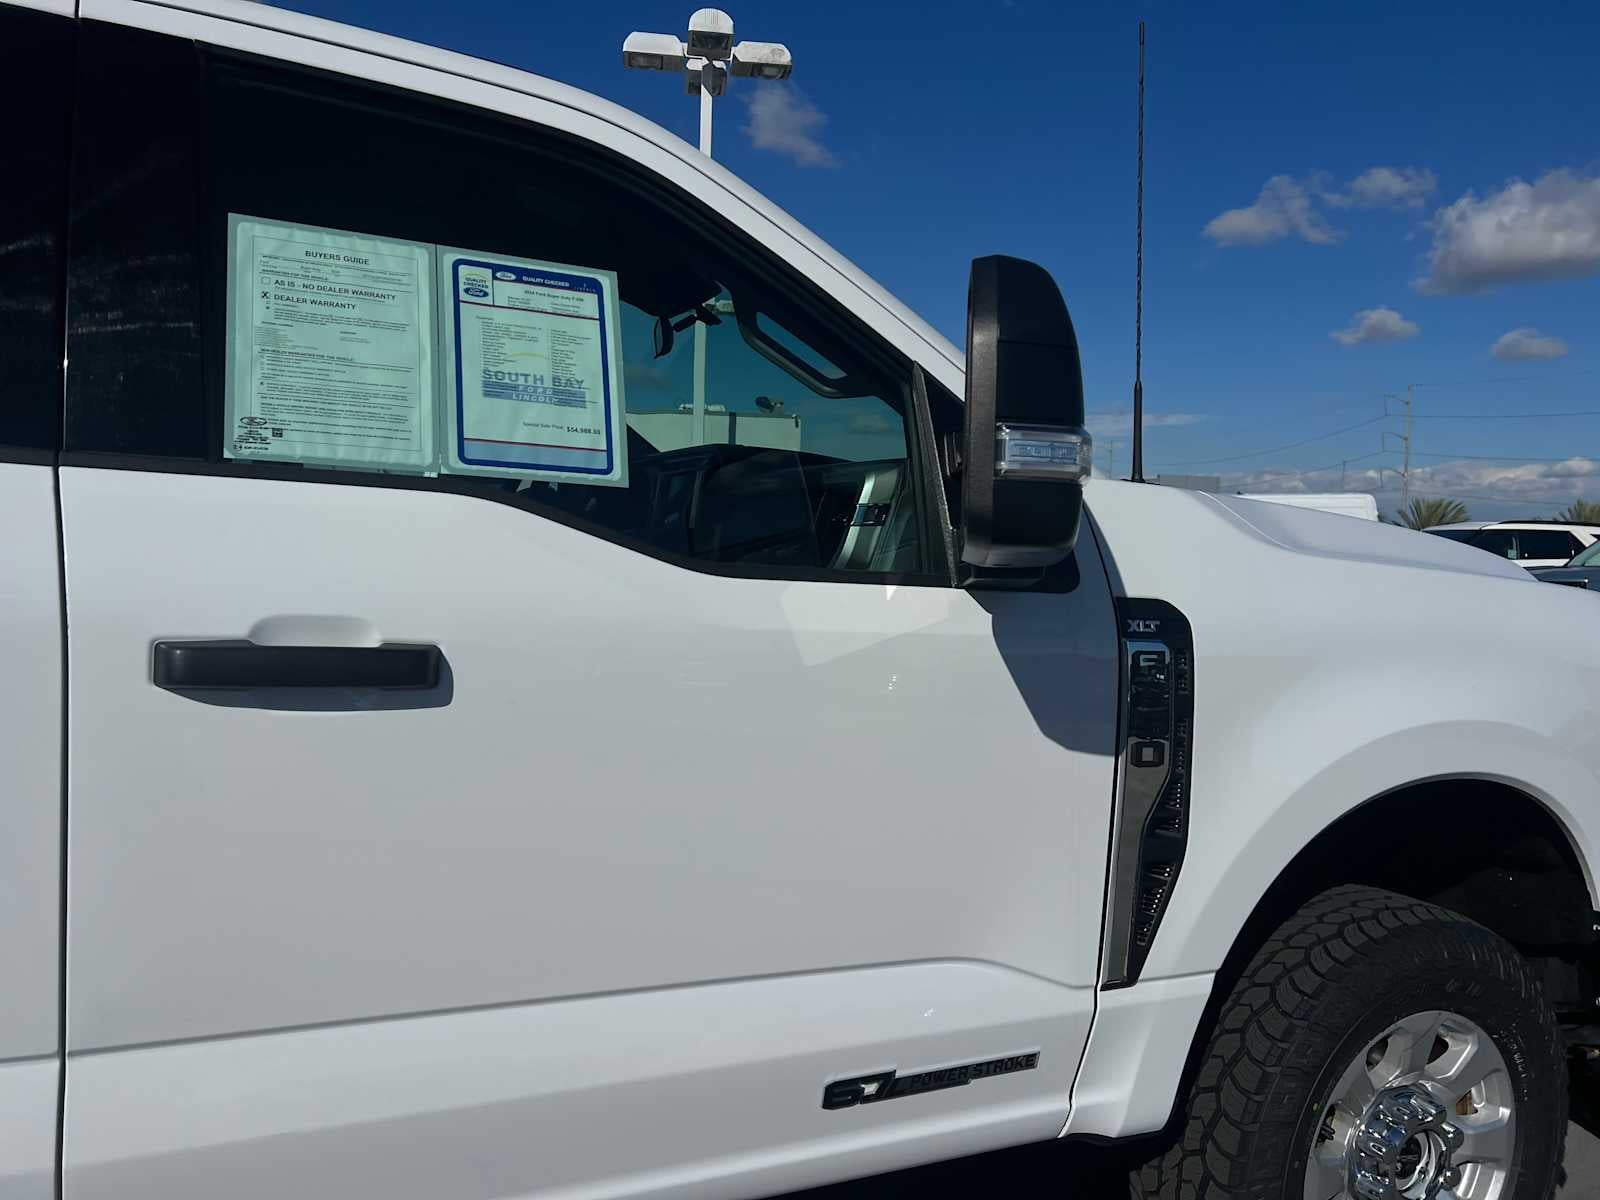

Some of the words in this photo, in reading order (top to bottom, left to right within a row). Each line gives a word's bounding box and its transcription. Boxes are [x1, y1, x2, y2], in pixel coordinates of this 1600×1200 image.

[305, 250, 341, 262] BUYERS
[343, 255, 370, 265] GUIDE
[522, 275, 544, 283] QUALITY
[274, 279, 286, 287] AS
[287, 280, 296, 288] IS
[302, 282, 315, 290] NO
[317, 284, 350, 296] DEALER
[352, 289, 396, 301] WARRANTY
[274, 294, 308, 305] DEALER
[309, 298, 356, 310] WARRANTY
[482, 368, 544, 385] SOUTH
[551, 376, 585, 390] BAY
[512, 392, 559, 403] LINCOLN
[518, 385, 553, 395] FORD
[1127, 619, 1161, 633] XLT
[910, 1066, 969, 1089] POWER
[971, 1053, 1037, 1077] STROKE
